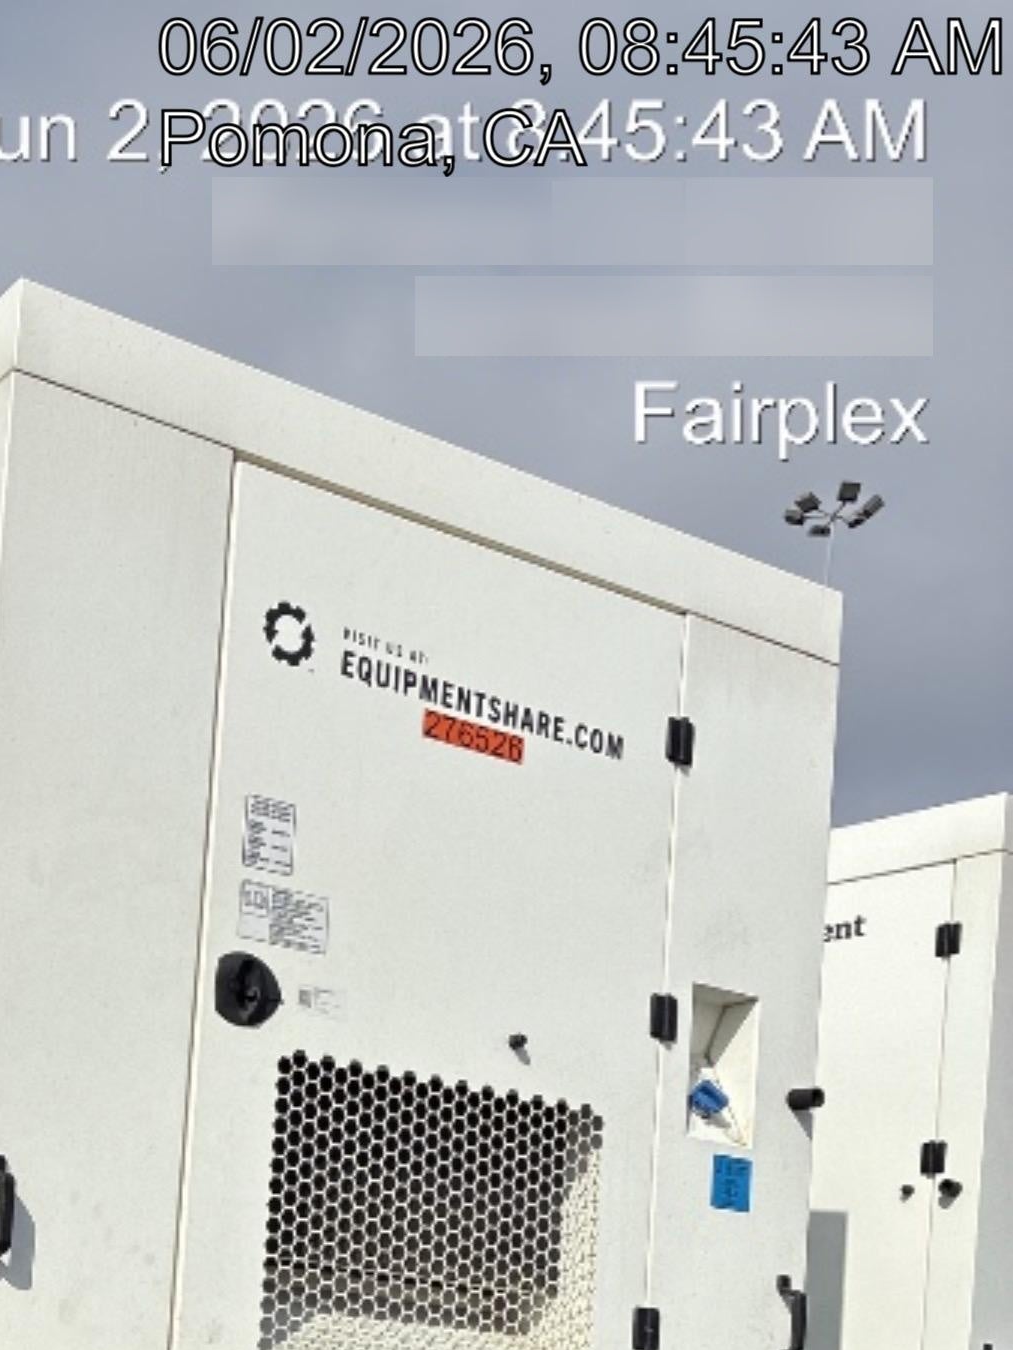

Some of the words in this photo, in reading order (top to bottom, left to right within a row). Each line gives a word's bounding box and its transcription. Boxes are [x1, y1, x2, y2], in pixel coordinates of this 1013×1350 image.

[343, 626, 381, 651] VISIT
[341, 650, 625, 761] EQUIPMENTSHARE.COM
[423, 710, 525, 764] 276526
